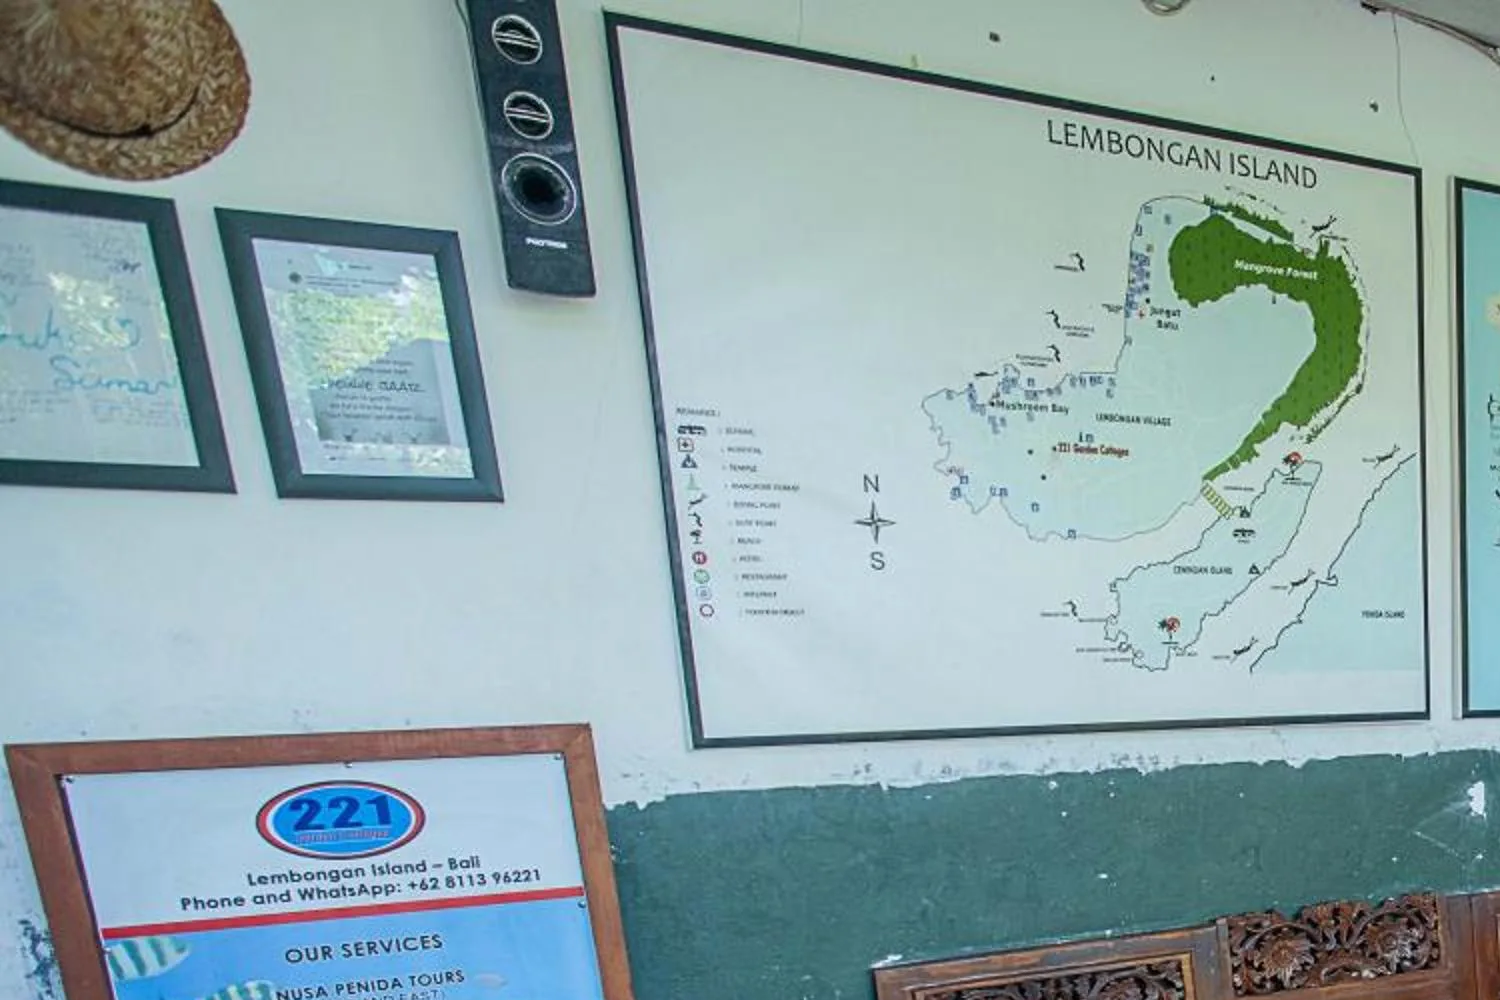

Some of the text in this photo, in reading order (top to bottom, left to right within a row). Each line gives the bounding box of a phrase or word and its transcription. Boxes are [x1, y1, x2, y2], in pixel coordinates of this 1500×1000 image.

[1047, 120, 1317, 190] LEMBONGAN ISLAND
[1233, 259, 1318, 281] Mangrove Forest
[1149, 306, 1181, 319] Jungut
[1156, 319, 1179, 331] Batu
[995, 399, 1069, 415] Mushroom Bay
[1095, 413, 1171, 427] LEMBONGAN VILLAGE
[863, 475, 880, 493] N
[870, 551, 886, 571] S
[290, 795, 391, 831] 221
[248, 866, 365, 888] Lembongan
[372, 859, 427, 878] Island
[448, 856, 480, 870] Bali
[181, 869, 541, 911] Phone and WhatsApp: +62 8113 96221
[285, 934, 443, 963] OUR SERVICES
[335, 977, 402, 996] PENIDA
[409, 969, 465, 987] TOURS
